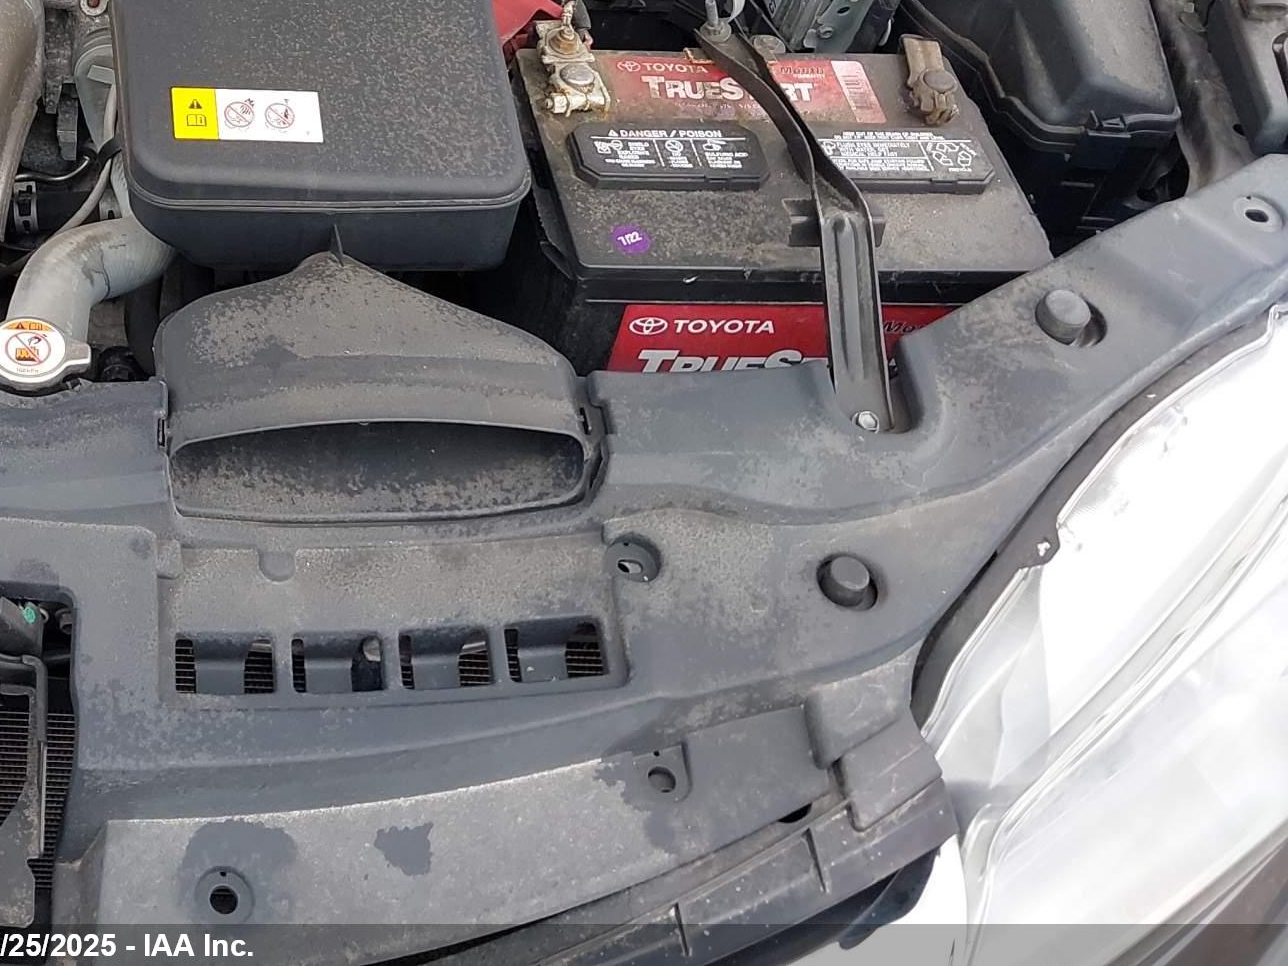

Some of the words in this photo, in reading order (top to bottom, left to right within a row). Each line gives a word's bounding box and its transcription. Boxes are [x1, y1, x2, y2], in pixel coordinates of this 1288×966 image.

[642, 62, 709, 73] TOYOTA
[640, 74, 814, 102] TRUESRT
[619, 129, 668, 138] DANGER
[678, 129, 723, 138] POISON
[674, 319, 775, 334] TOYOTA
